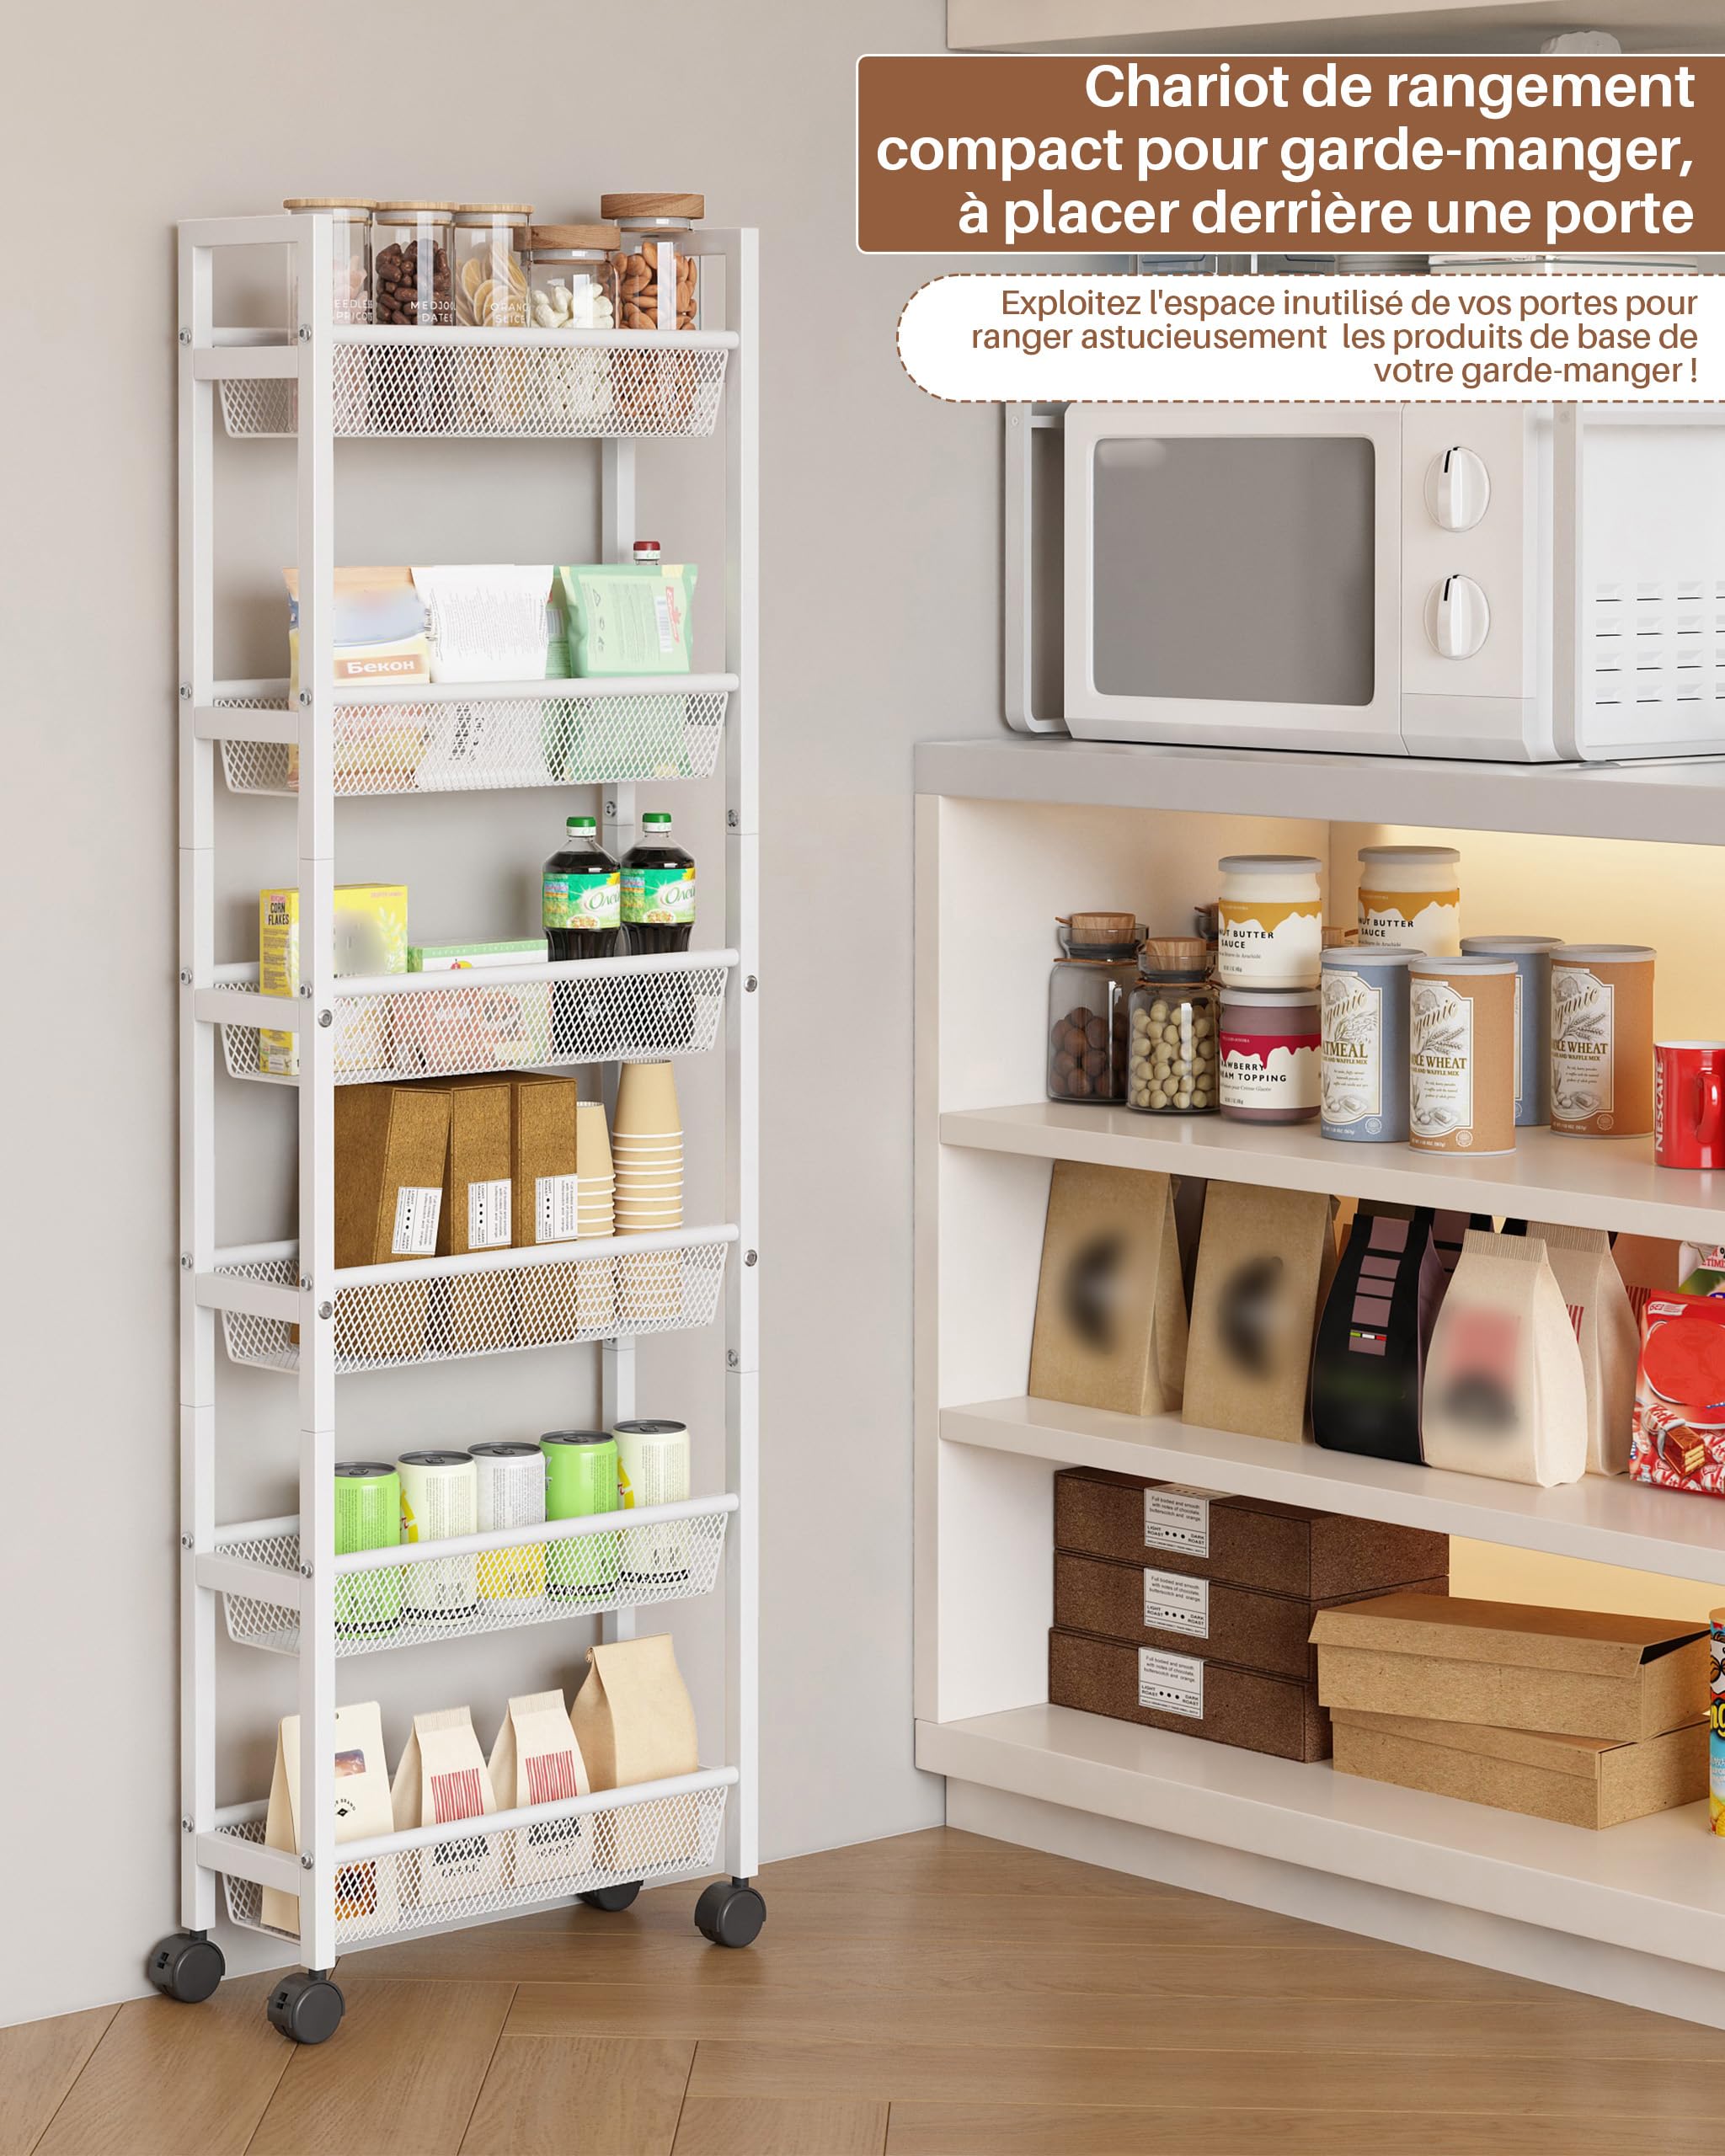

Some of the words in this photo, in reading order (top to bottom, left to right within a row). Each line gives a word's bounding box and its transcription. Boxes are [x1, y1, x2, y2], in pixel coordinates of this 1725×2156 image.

[346, 660, 415, 675] Бекон
[268, 914, 290, 926] FLAKES
[1374, 918, 1414, 928] BUTTER
[1233, 930, 1274, 939] BUTTER
[1361, 927, 1386, 937] SAUCE
[1567, 1041, 1608, 1054] WHEAT
[1426, 1055, 1467, 1070] WHEAT
[1238, 1072, 1287, 1083] TOPPING
